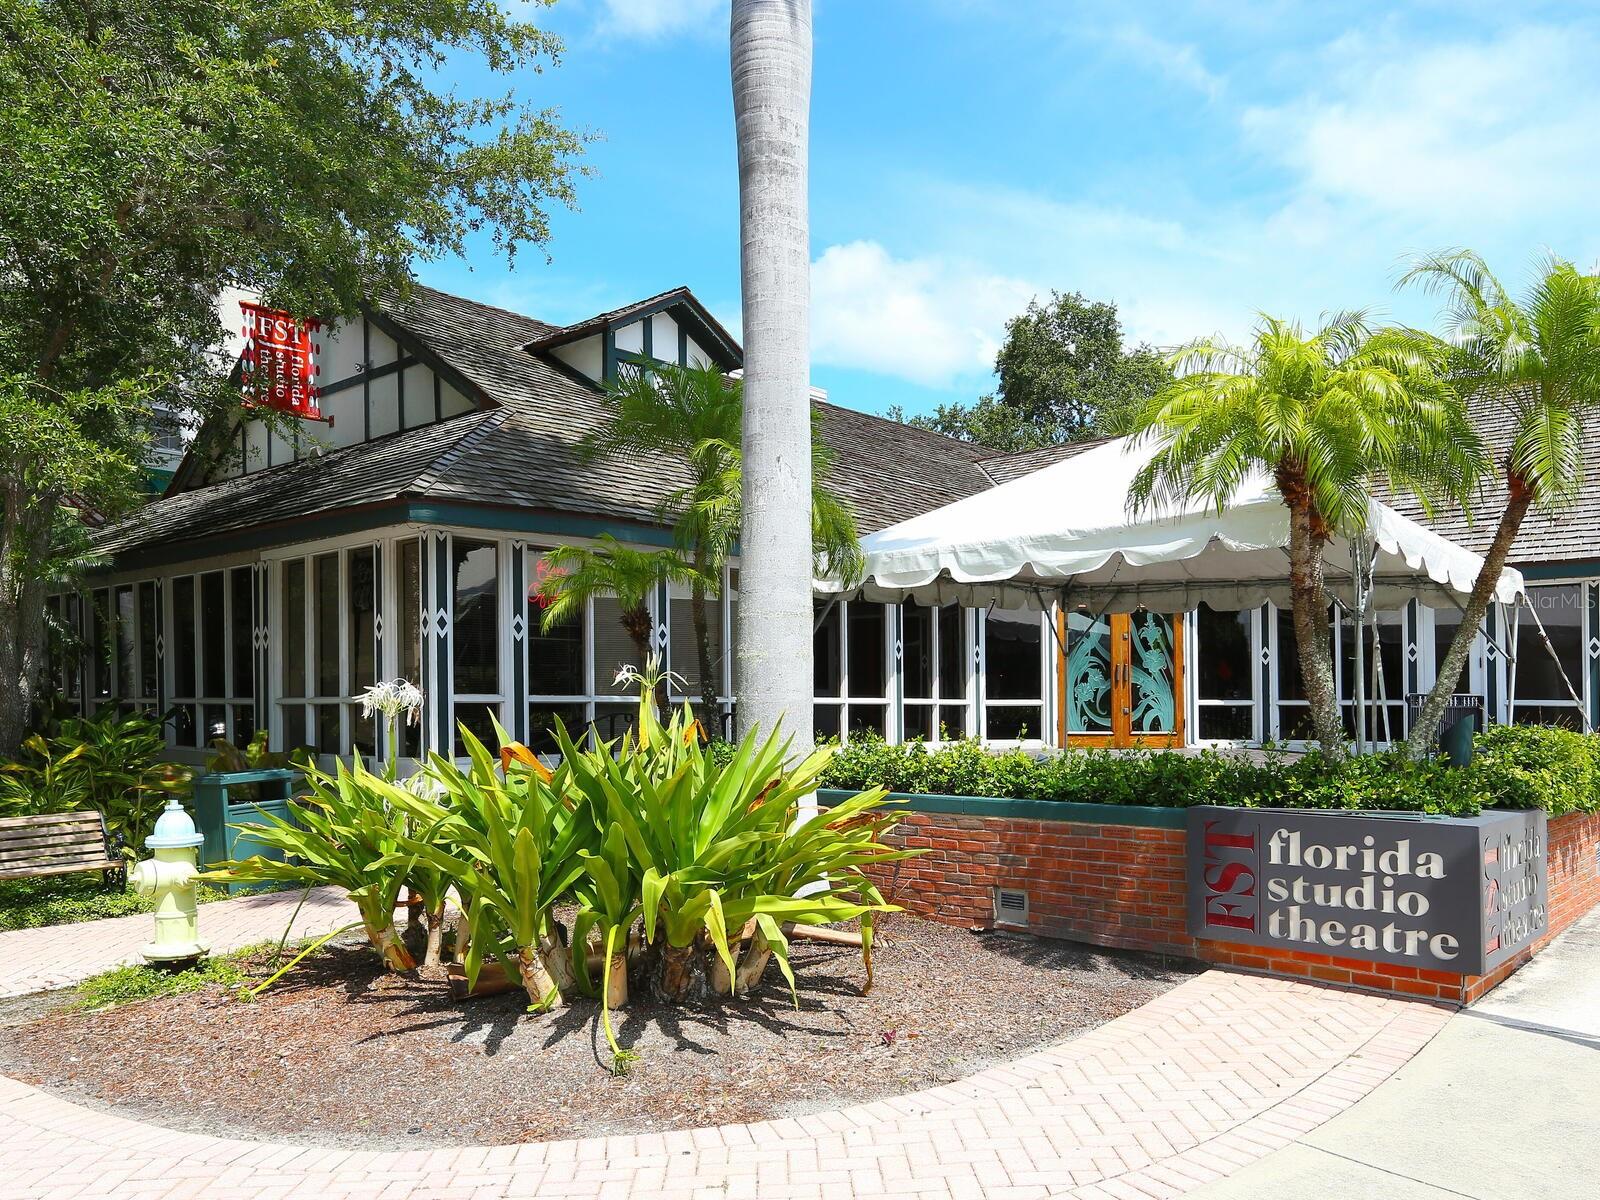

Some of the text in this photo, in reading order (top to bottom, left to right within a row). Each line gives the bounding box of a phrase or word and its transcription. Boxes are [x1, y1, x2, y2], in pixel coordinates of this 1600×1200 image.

[258, 316, 305, 344] FST
[260, 349, 273, 402] there
[275, 351, 288, 398] studio
[291, 355, 304, 406] florida
[1204, 820, 1255, 934] FST
[1268, 828, 1447, 880] florida
[1267, 875, 1430, 917] studio
[1268, 905, 1460, 961] theatre
